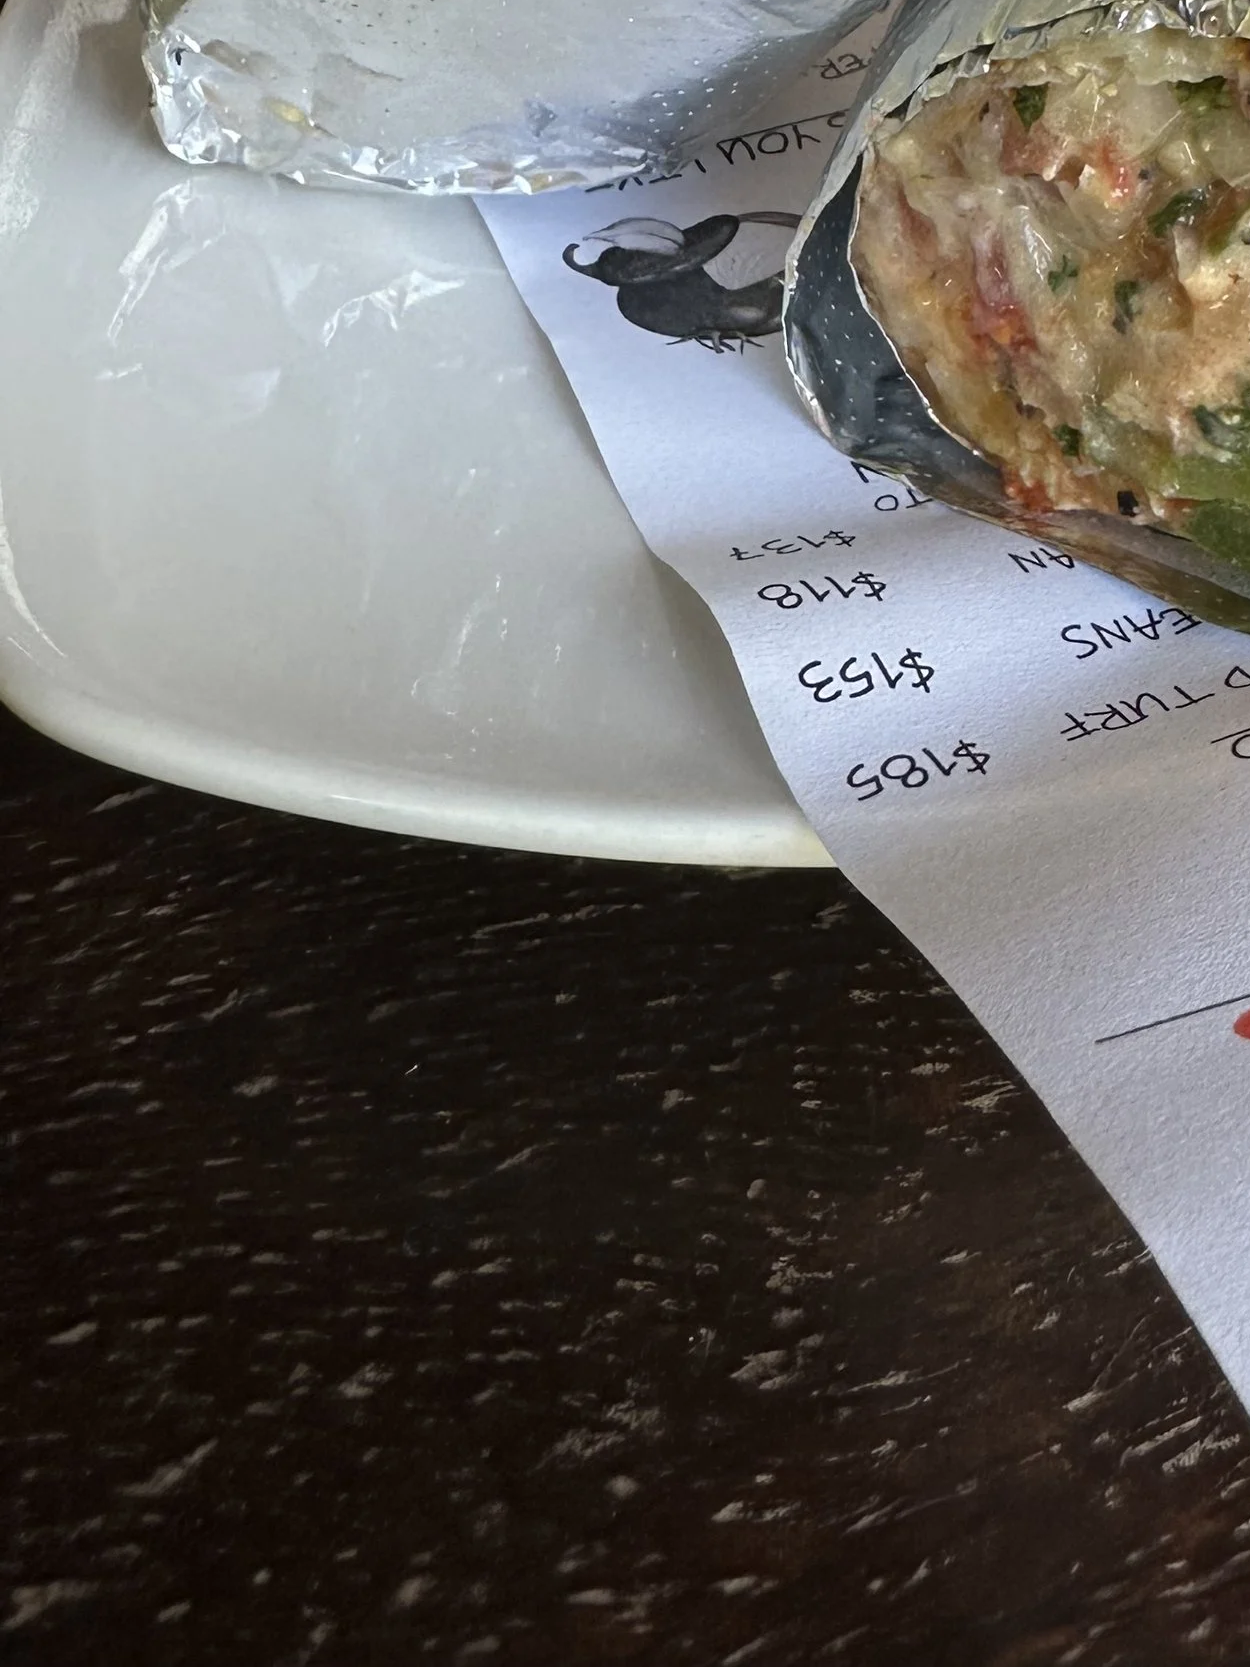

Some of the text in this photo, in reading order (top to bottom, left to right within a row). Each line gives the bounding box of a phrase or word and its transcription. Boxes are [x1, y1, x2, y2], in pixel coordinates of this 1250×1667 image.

[715, 124, 821, 165] YOU
[729, 530, 856, 561] $137
[756, 571, 887, 610] $118
[797, 607, 1203, 703] EANS $153
[1059, 684, 1216, 743] TURF
[846, 738, 991, 802] $185
